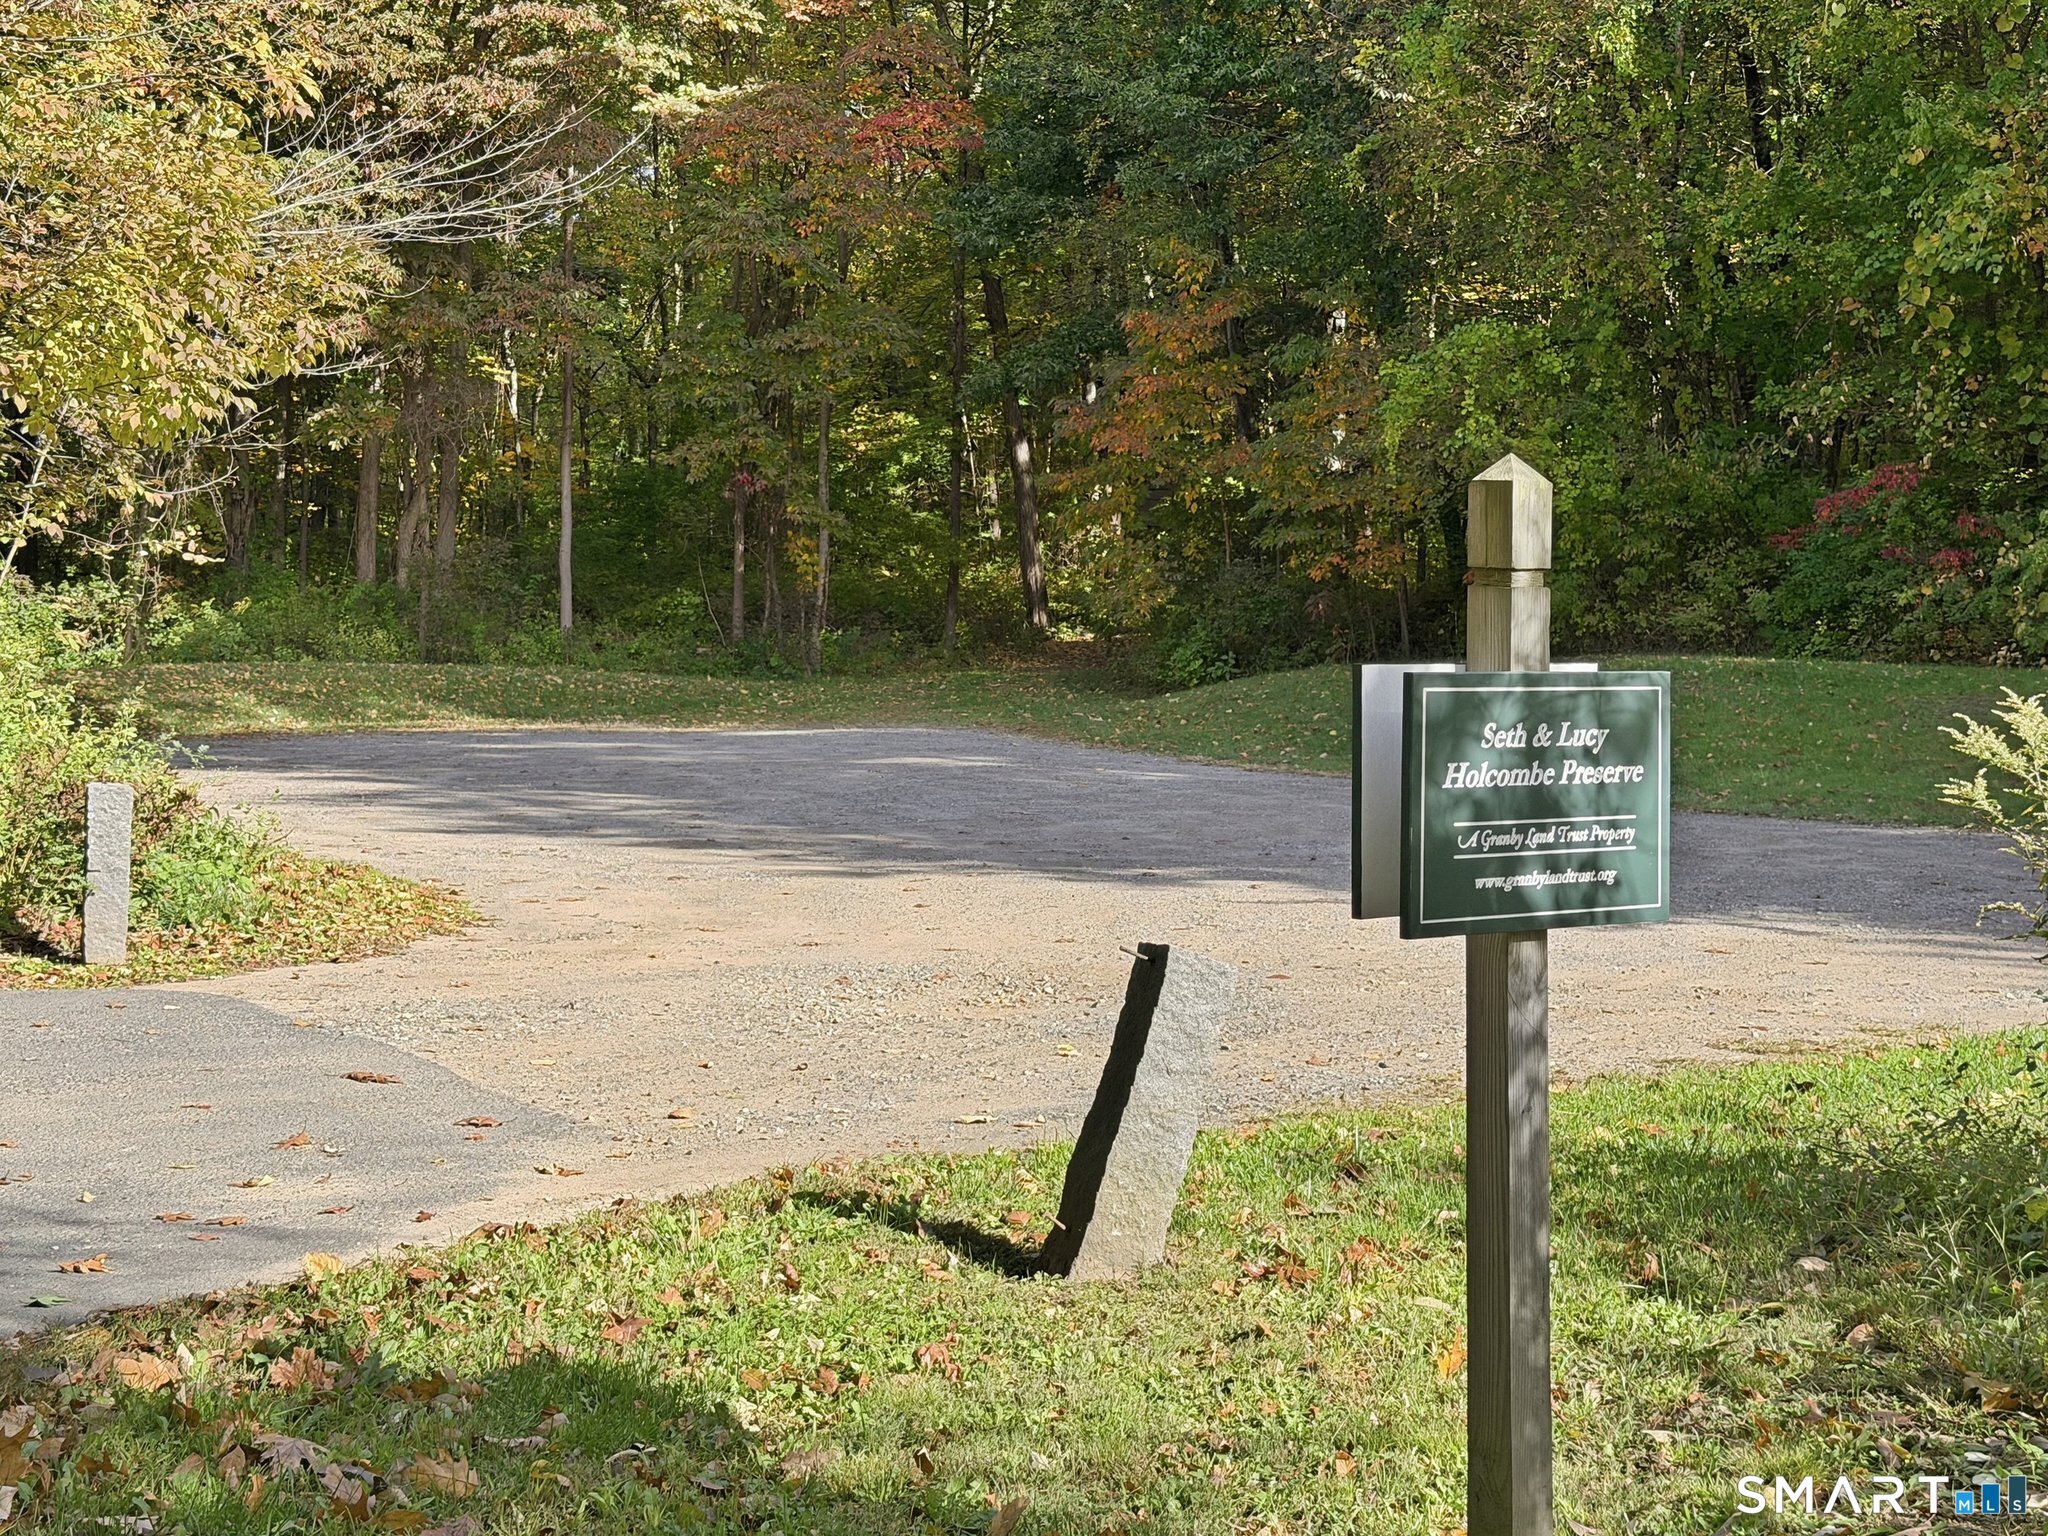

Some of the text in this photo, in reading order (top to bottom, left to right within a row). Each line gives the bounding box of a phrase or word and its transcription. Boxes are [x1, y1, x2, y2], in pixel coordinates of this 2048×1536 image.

[1481, 721, 1610, 754] Seth & Lucy
[1442, 759, 1644, 789] Holcombe Preserve
[1457, 825, 1636, 852] A Granby Land Trust Property
[1474, 868, 1618, 892] www.granbylandtrust.org
